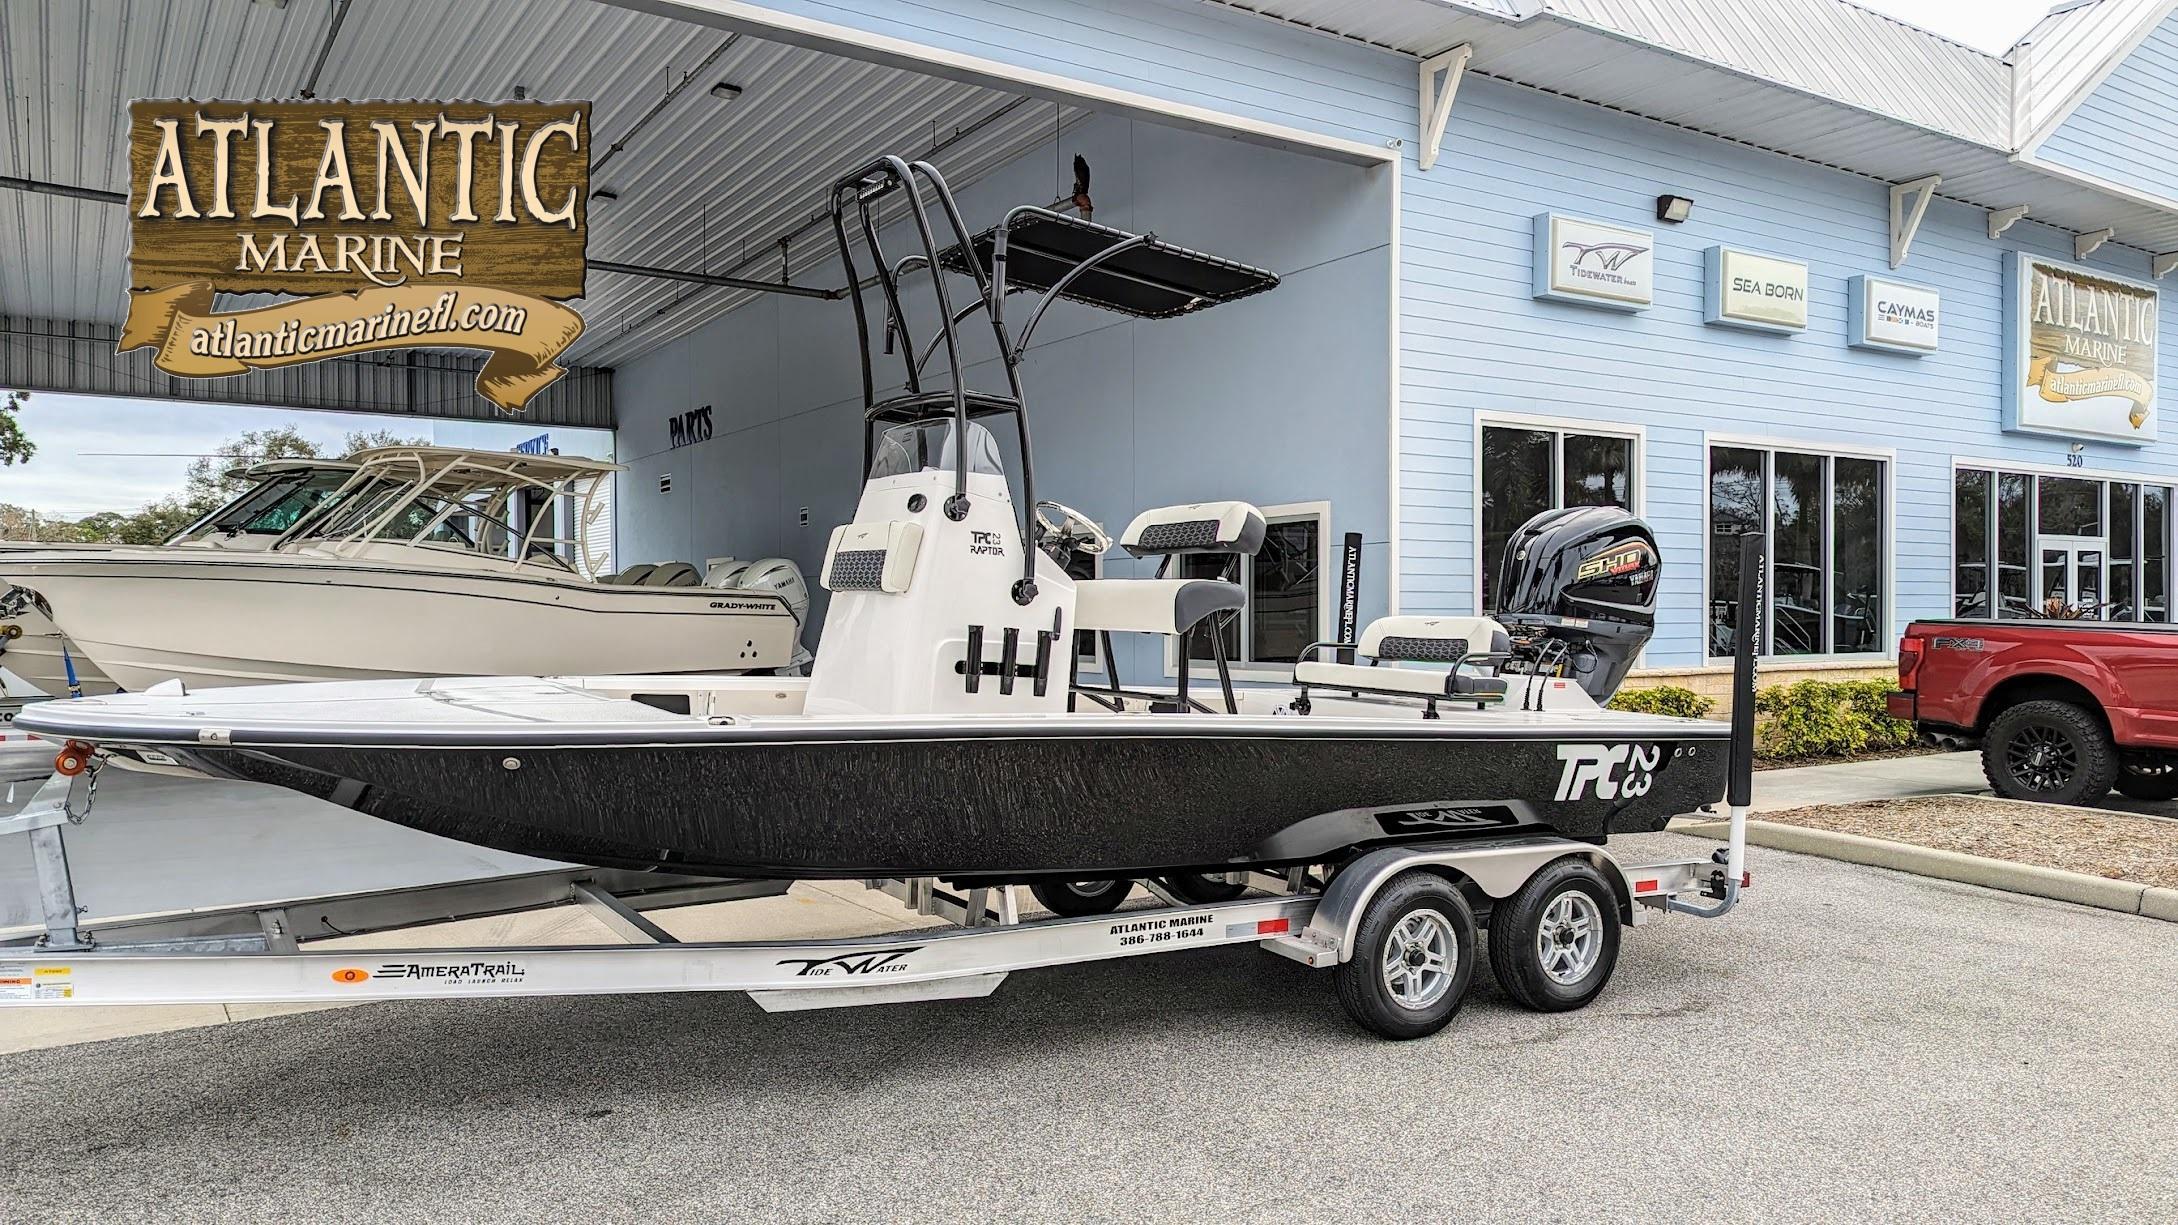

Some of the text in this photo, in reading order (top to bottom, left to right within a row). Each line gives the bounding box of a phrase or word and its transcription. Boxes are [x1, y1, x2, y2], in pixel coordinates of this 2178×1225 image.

[1570, 265, 1624, 284] TIDEWATER
[1733, 277, 1803, 302] SEA BORN
[1878, 300, 1935, 322] CAYMAS
[2033, 273, 2154, 347] ATLANTIC
[2064, 334, 2127, 367] MARINE
[2050, 373, 2142, 396] atlanticmarinefl.com
[669, 405, 713, 449] PARTS
[2066, 454, 2083, 467] 520
[970, 531, 991, 545] TPC
[970, 545, 1005, 557] RAPTOR
[1578, 550, 1641, 580] SHO
[709, 601, 777, 611] GRADY-WHITE
[1932, 637, 1985, 651] FX4
[1554, 744, 1660, 801] TPC 23
[1110, 914, 1214, 935] ATLANTIC MARINE
[1120, 928, 1204, 946] 386-788-1644
